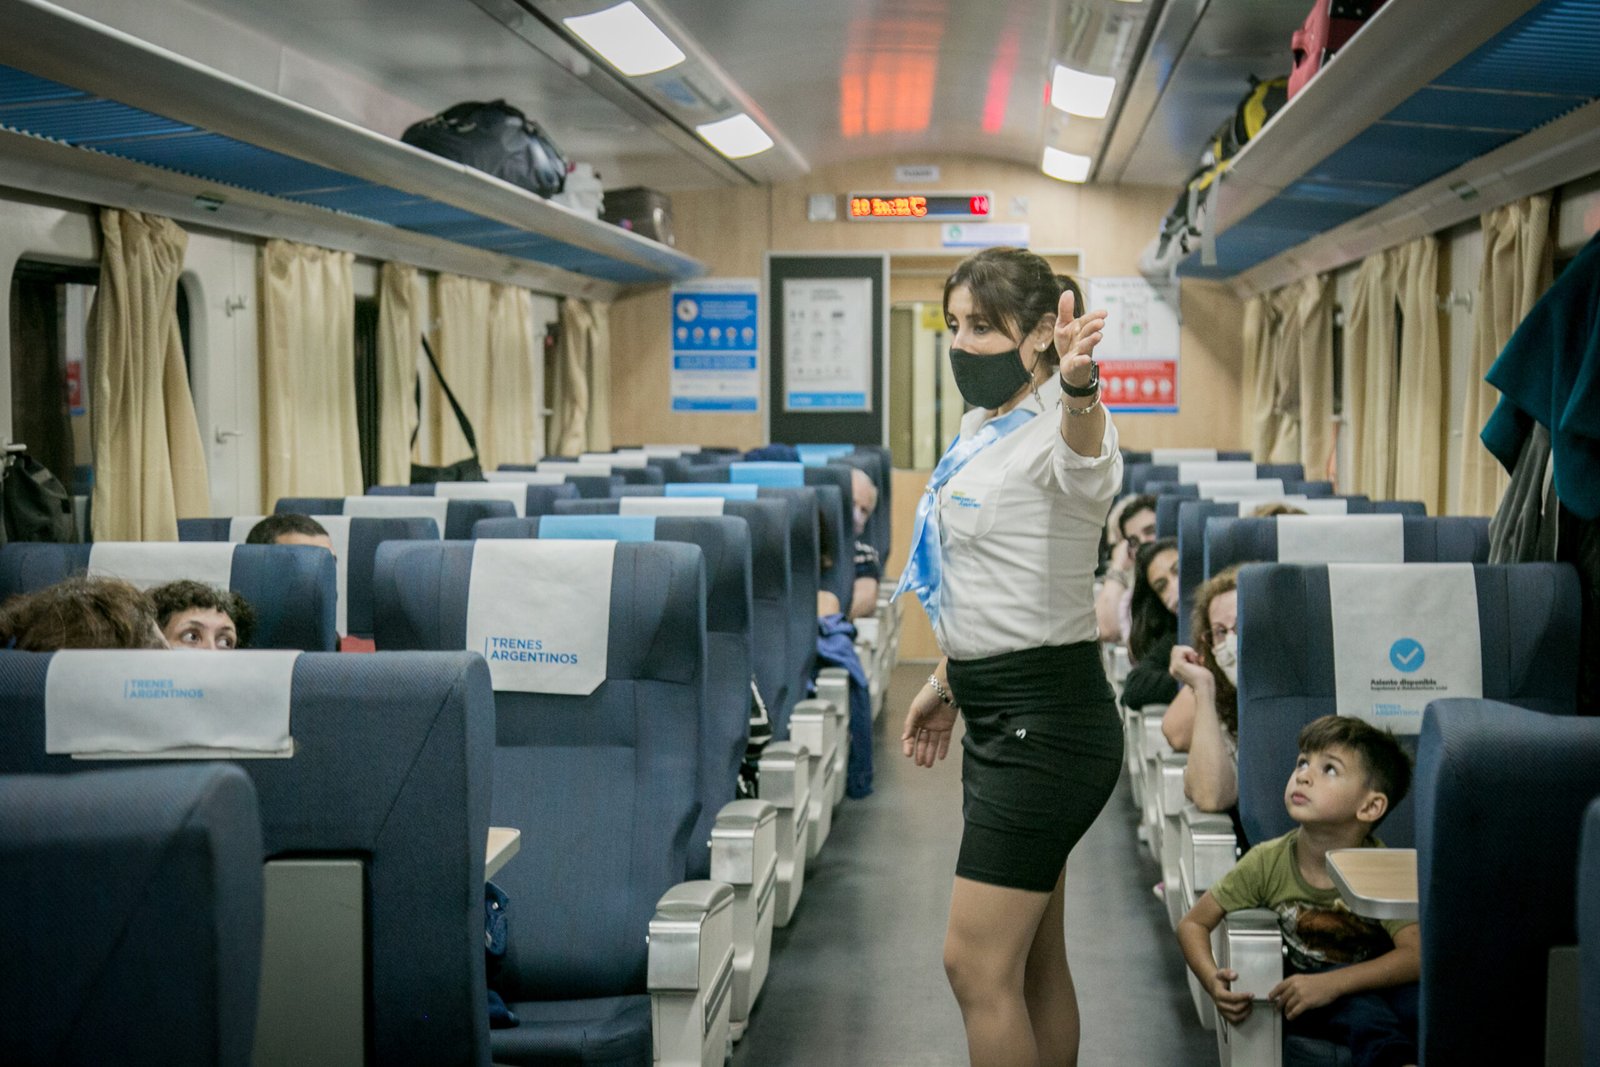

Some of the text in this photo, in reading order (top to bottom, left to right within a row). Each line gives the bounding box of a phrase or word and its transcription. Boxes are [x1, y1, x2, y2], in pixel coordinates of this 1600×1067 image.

[491, 637, 543, 650] TRENES
[490, 651, 578, 665] ARGENTINOS
[130, 679, 173, 688] TRENES
[1400, 678, 1437, 687] disponible
[129, 689, 204, 699] ARGENTINOS
